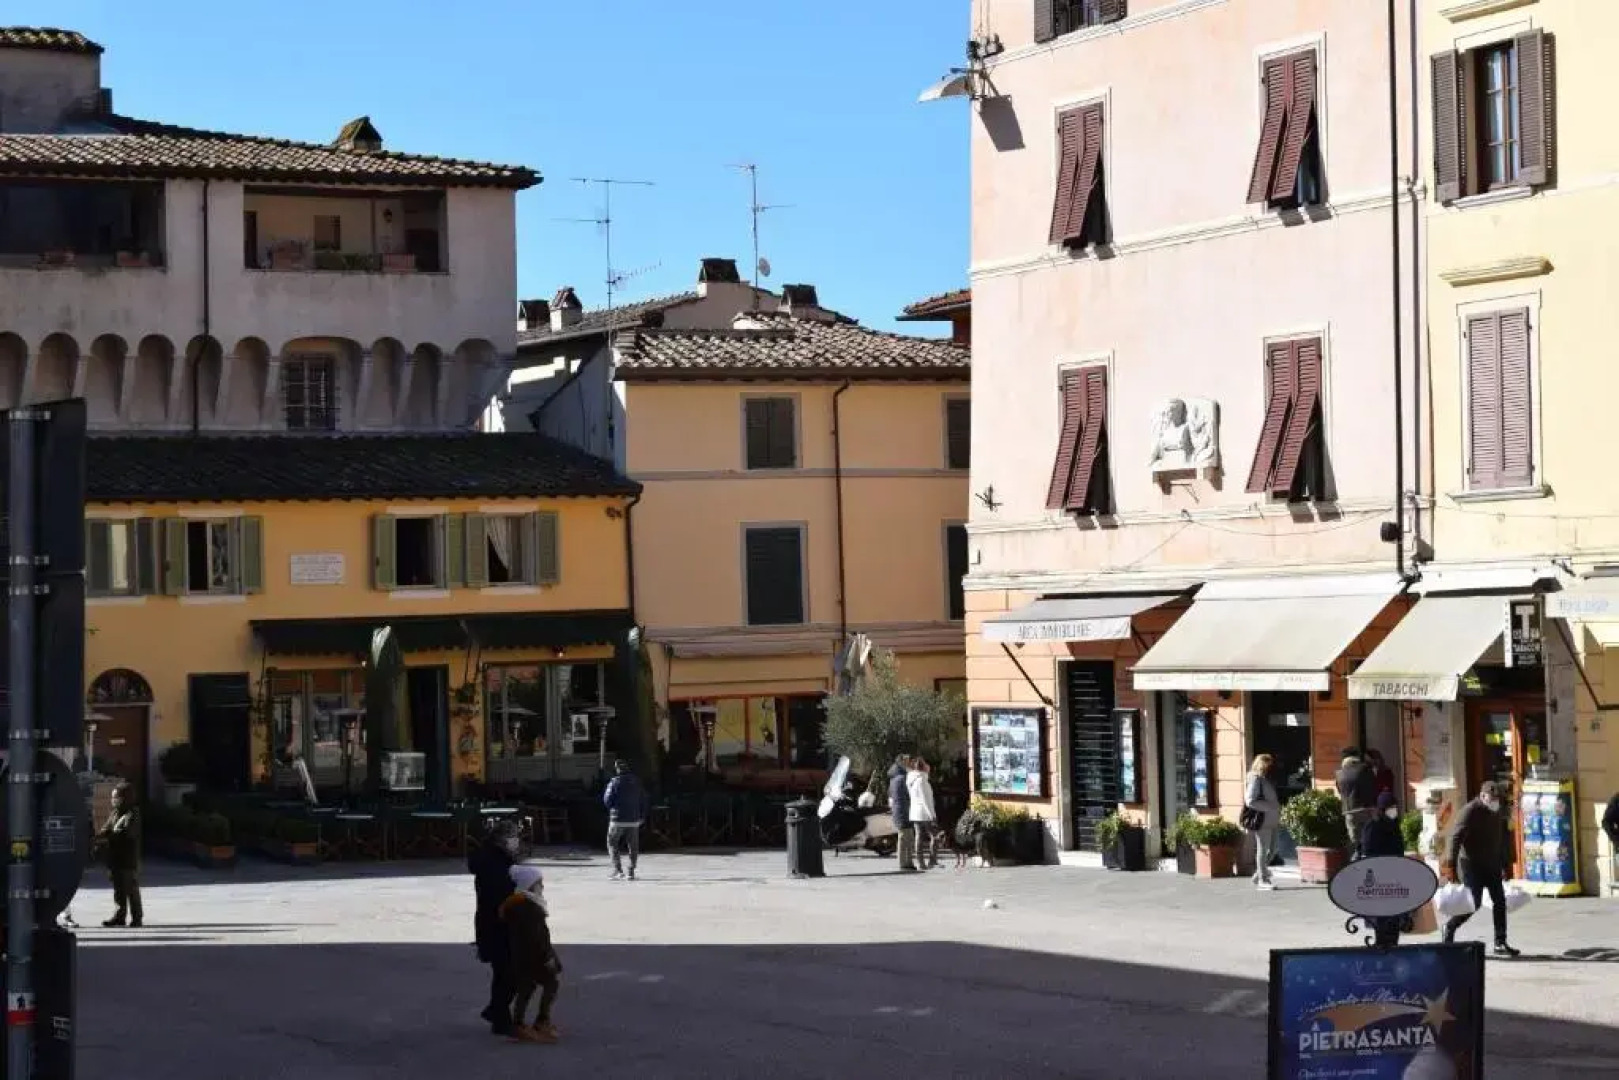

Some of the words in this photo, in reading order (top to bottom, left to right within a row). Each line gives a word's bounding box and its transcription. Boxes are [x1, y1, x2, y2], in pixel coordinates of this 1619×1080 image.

[1515, 605, 1535, 640] T
[1372, 682, 1429, 696] TABACCHI
[1299, 1026, 1437, 1052] PIETRASANTA
